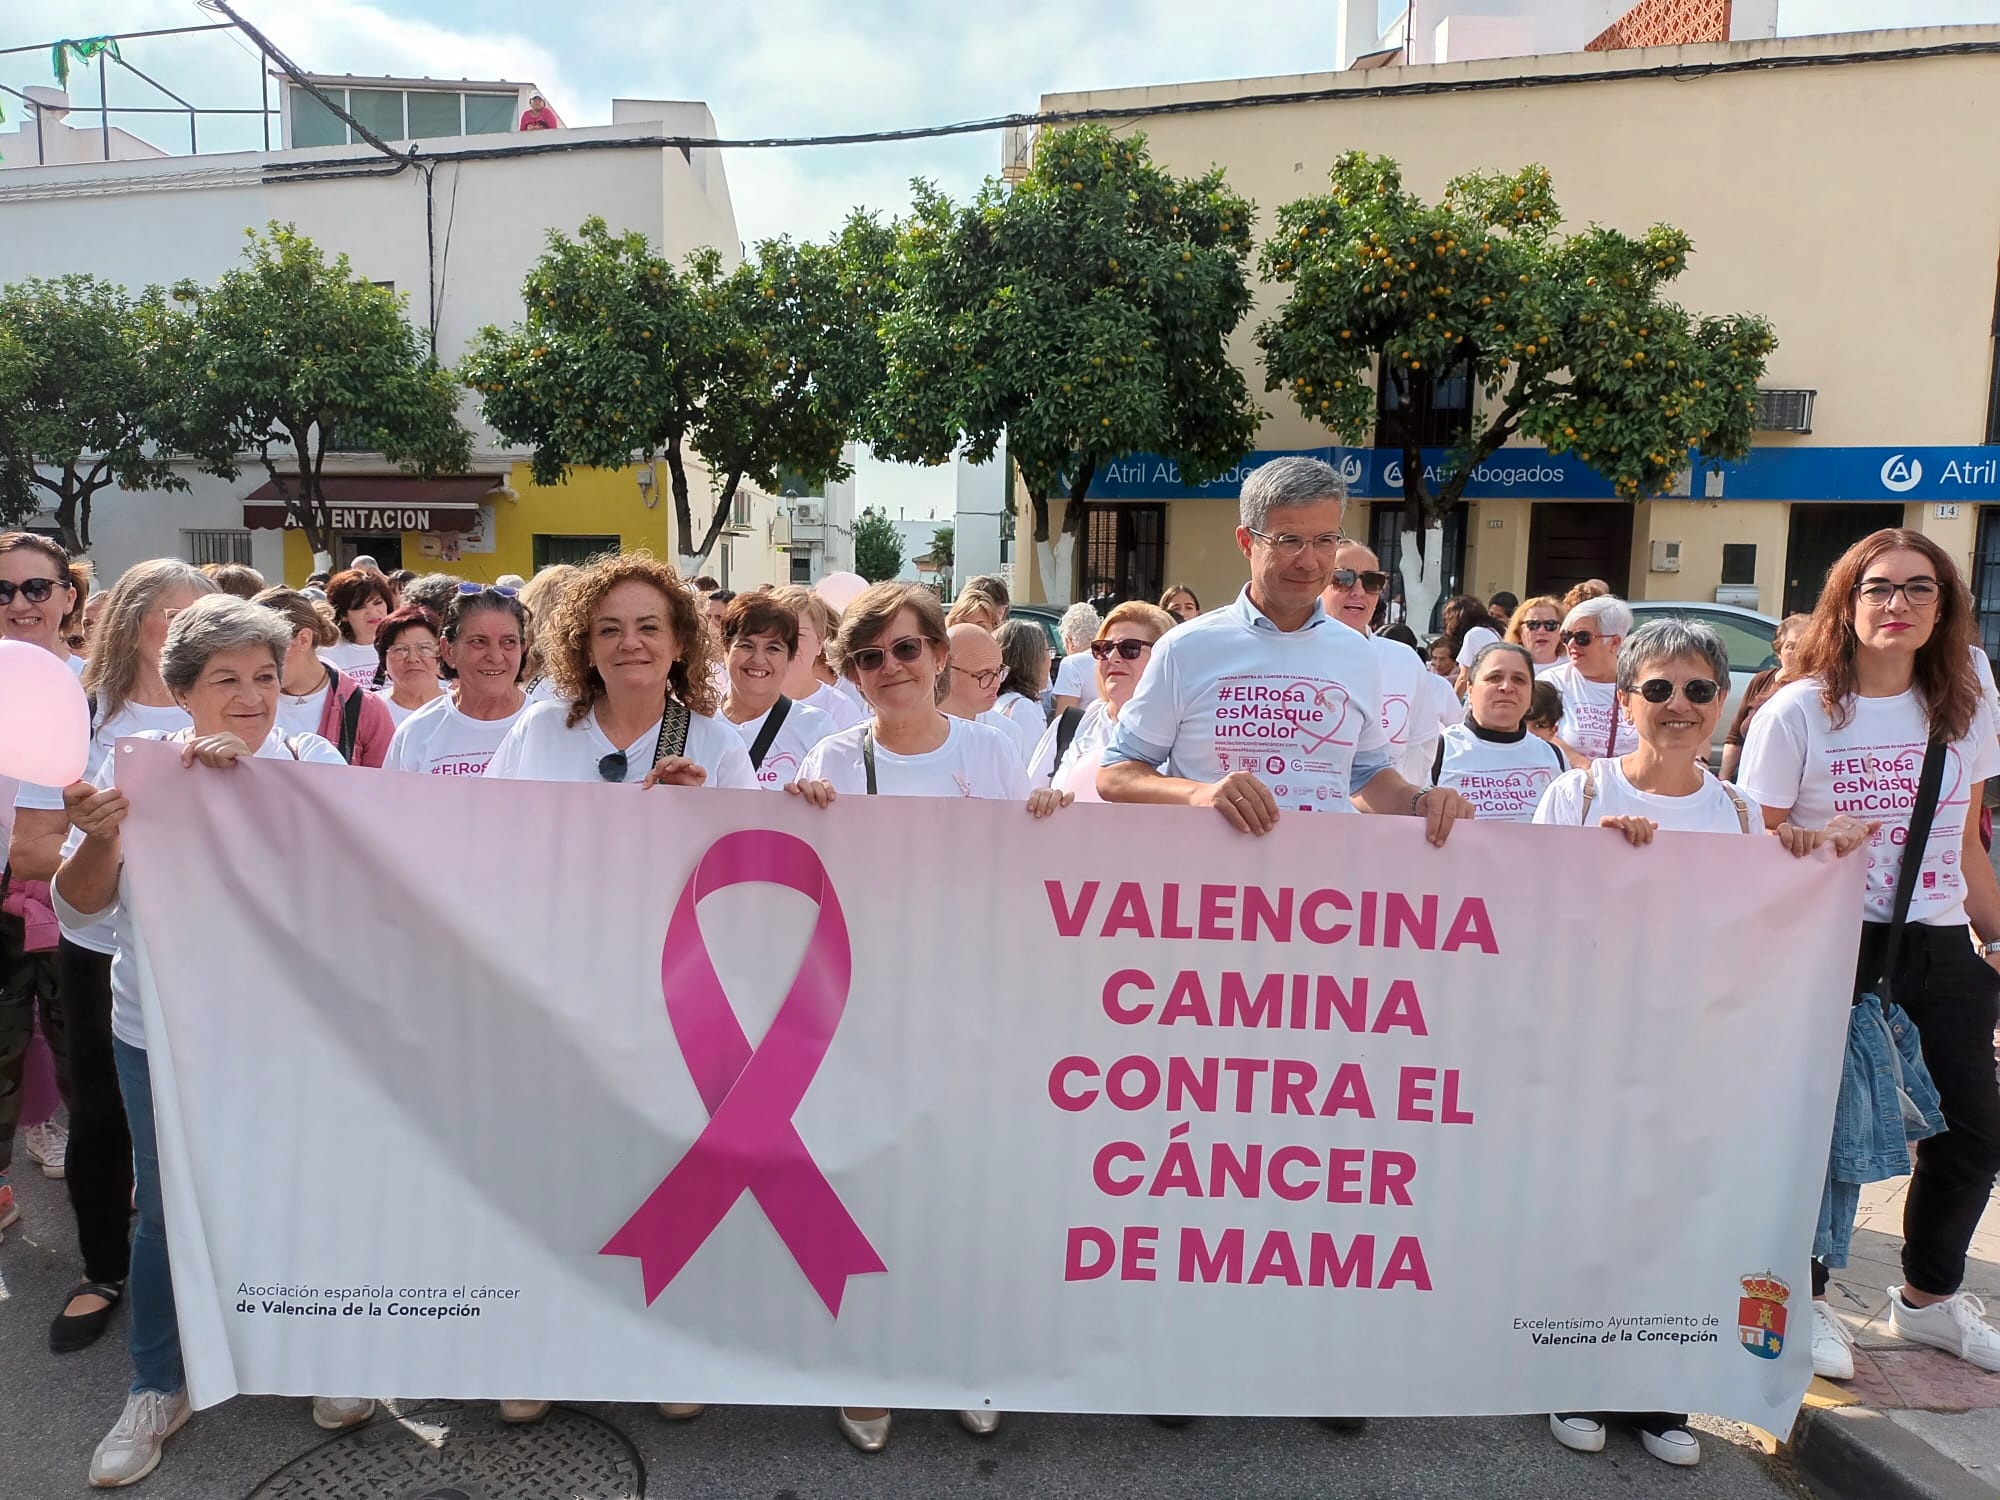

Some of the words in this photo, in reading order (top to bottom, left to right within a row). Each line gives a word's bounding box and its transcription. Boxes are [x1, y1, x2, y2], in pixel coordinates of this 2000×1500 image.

[1105, 462, 1145, 483] Atril
[1939, 460, 1997, 485] Atril
[285, 509, 430, 529] AENTACION
[1939, 506, 1955, 516] 14
[1217, 686, 1305, 702] #ElRosa
[1215, 703, 1324, 725] esMásque
[1215, 722, 1299, 739] unColor
[1831, 757, 1914, 776] #ElRosa
[1460, 776, 1521, 788] #ElRosa
[1833, 775, 1920, 794] esMásqu
[1474, 801, 1523, 811] nColor
[1044, 880, 1500, 954] VALENCINA
[1102, 969, 1428, 1036] CAMINA
[1048, 1055, 1376, 1119] CONTRA
[1397, 1066, 1474, 1125] EL
[1092, 1120, 1417, 1206] CÁNCER
[1064, 1226, 1160, 1281] DE
[1177, 1227, 1433, 1291] MAMA
[237, 1282, 318, 1299] Asociación
[324, 1284, 393, 1302] española
[399, 1286, 447, 1299] contra
[452, 1285, 465, 1299] el
[470, 1285, 520, 1300] cáncer
[236, 1301, 255, 1313] de
[262, 1301, 337, 1316] Valencina
[342, 1302, 363, 1316] de
[369, 1302, 382, 1316] la
[387, 1302, 481, 1319] Concepción
[1513, 1316, 1604, 1330] Excelentísimo
[1607, 1313, 1698, 1329] Ayuntamiento
[1701, 1313, 1720, 1327] de
[1531, 1331, 1597, 1345] Valencina
[1601, 1331, 1616, 1344] de
[1620, 1329, 1632, 1342] la
[1637, 1329, 1718, 1345] Concepción
